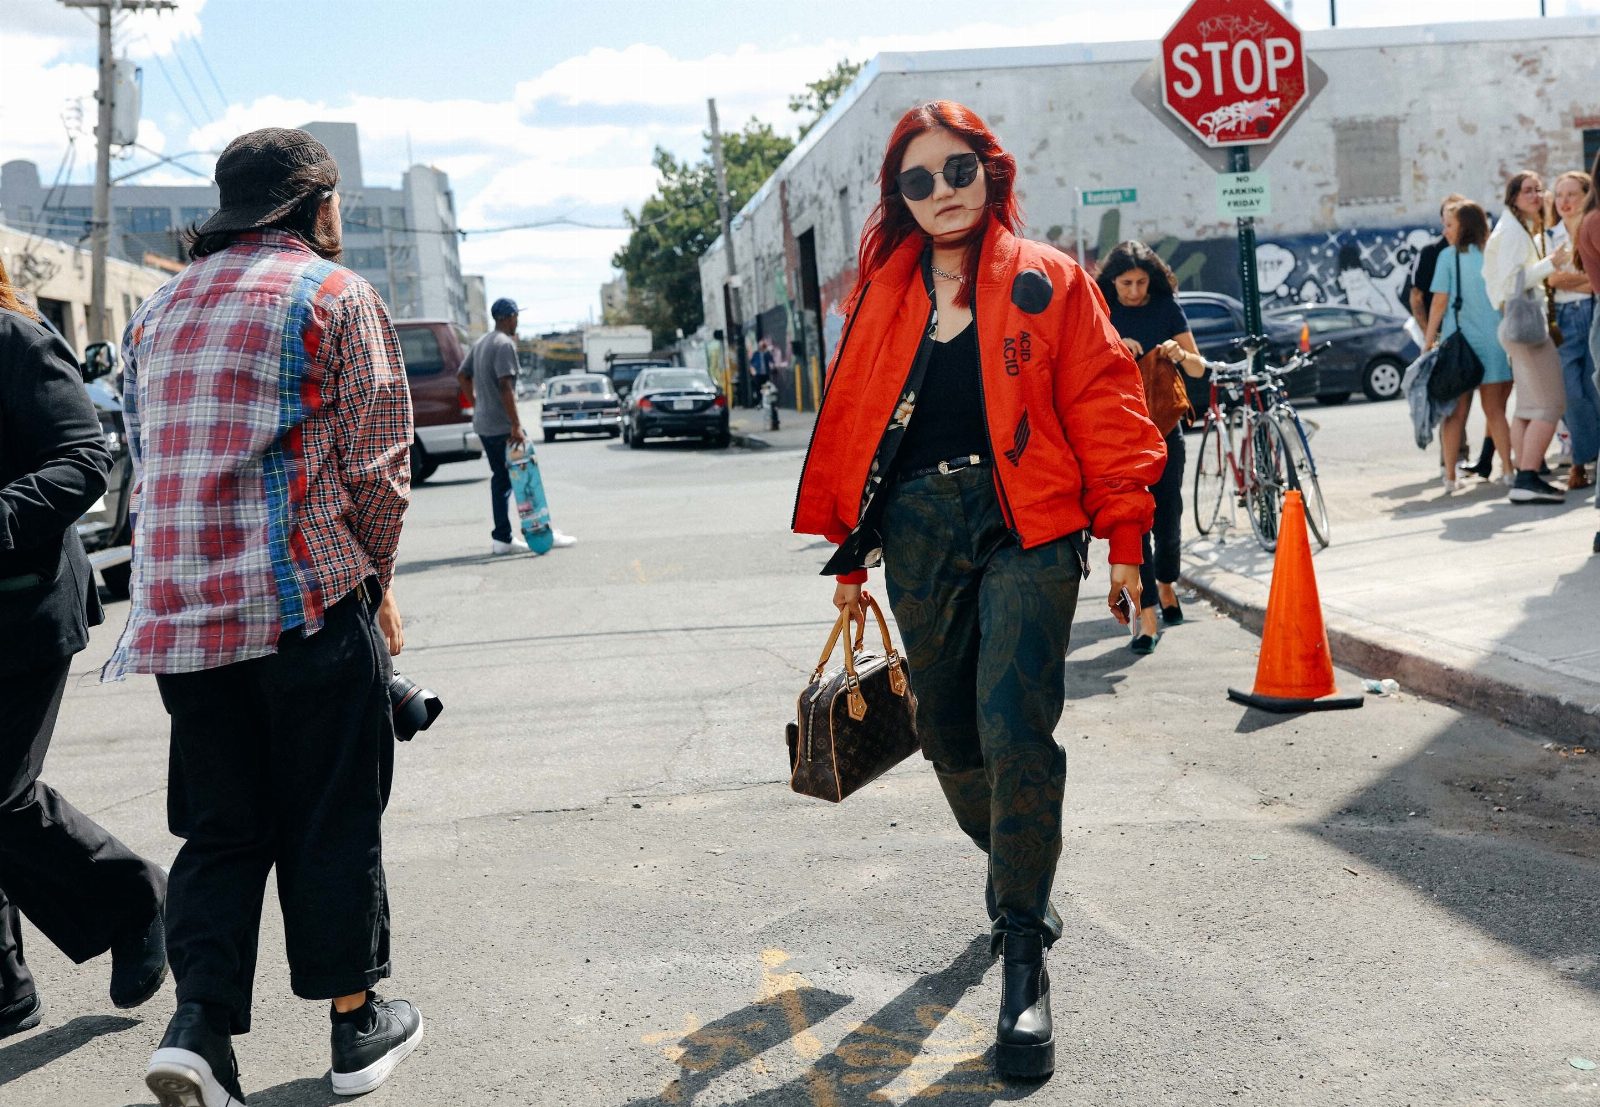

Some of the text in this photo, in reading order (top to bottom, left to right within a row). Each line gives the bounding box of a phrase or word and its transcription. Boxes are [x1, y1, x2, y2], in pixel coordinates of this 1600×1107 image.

[1172, 37, 1295, 98] STOP
[1222, 187, 1264, 195] PARKING
[1227, 199, 1260, 207] FRIDAY
[1003, 337, 1020, 377] ACID
[1020, 331, 1031, 362] ACID
